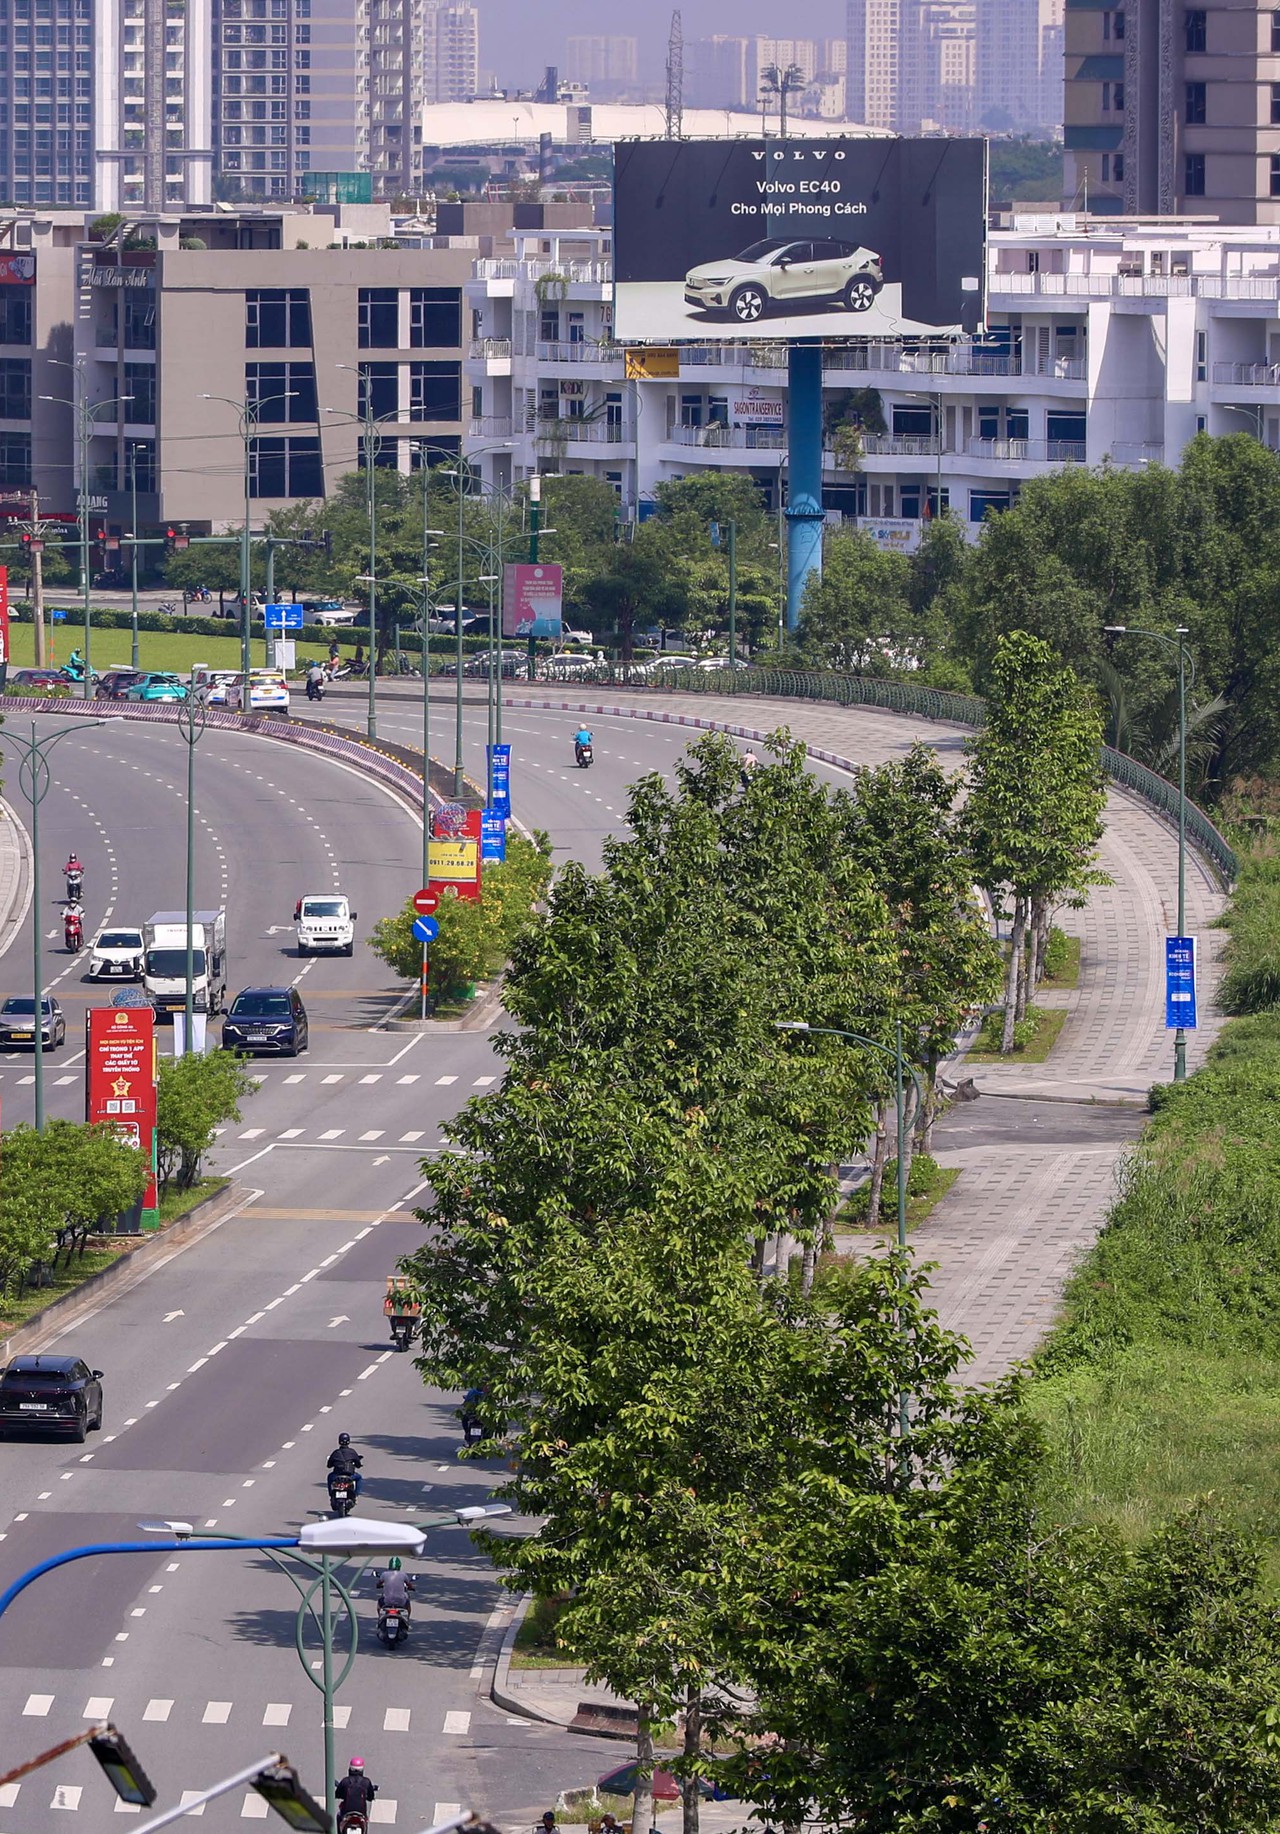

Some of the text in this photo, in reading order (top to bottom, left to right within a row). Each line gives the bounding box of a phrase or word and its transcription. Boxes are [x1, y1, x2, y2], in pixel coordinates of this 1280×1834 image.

[751, 151, 846, 160] VOLVO
[756, 181, 841, 193] Volvo EC40
[731, 202, 867, 216] Cho Mọi Phong Cách
